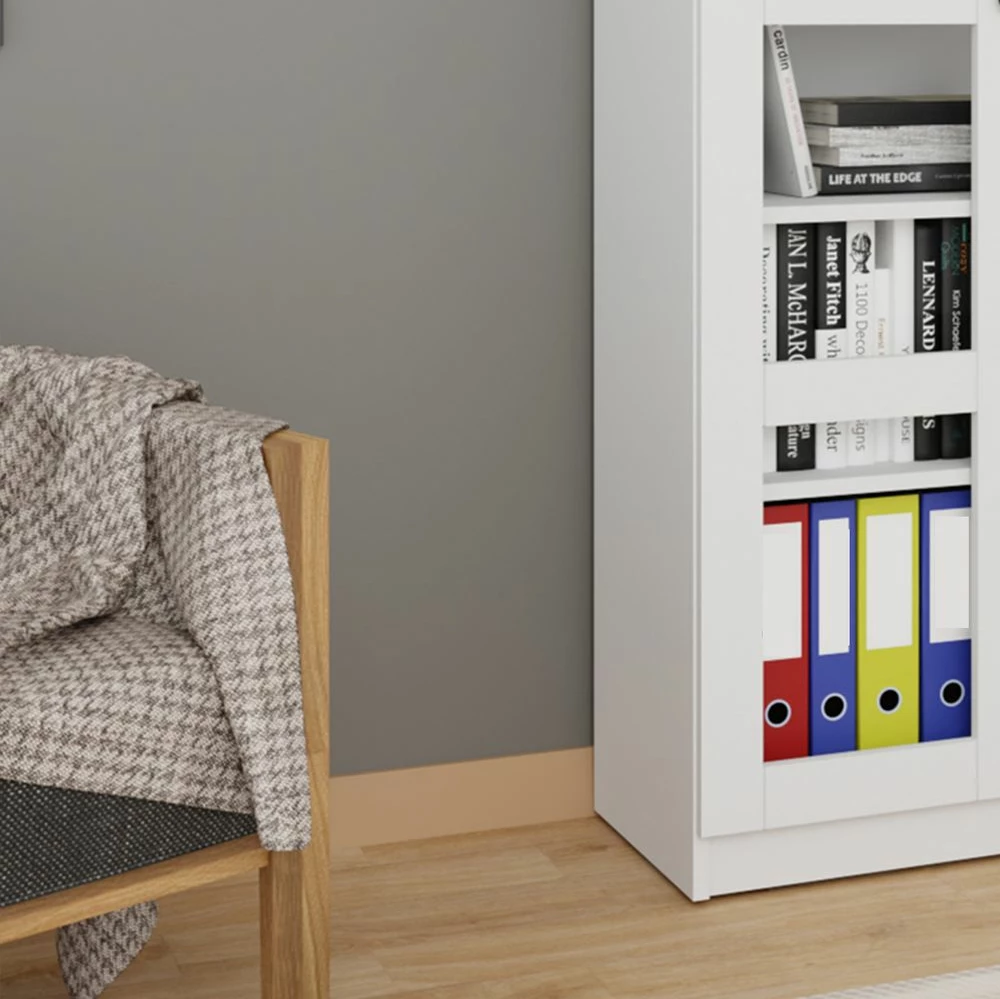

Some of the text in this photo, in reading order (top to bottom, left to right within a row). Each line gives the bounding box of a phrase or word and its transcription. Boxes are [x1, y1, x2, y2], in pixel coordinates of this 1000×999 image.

[773, 29, 789, 71] cardin
[828, 173, 852, 187] LIFE
[853, 172, 867, 185] AT
[868, 171, 892, 185] THE
[892, 170, 922, 184] EDGE
[787, 263, 807, 279] L.
[826, 235, 842, 358] Janet Fitch wh
[921, 260, 936, 352] LENNARD
[952, 289, 961, 309] Kim
[855, 283, 868, 355] 1100 Deco
